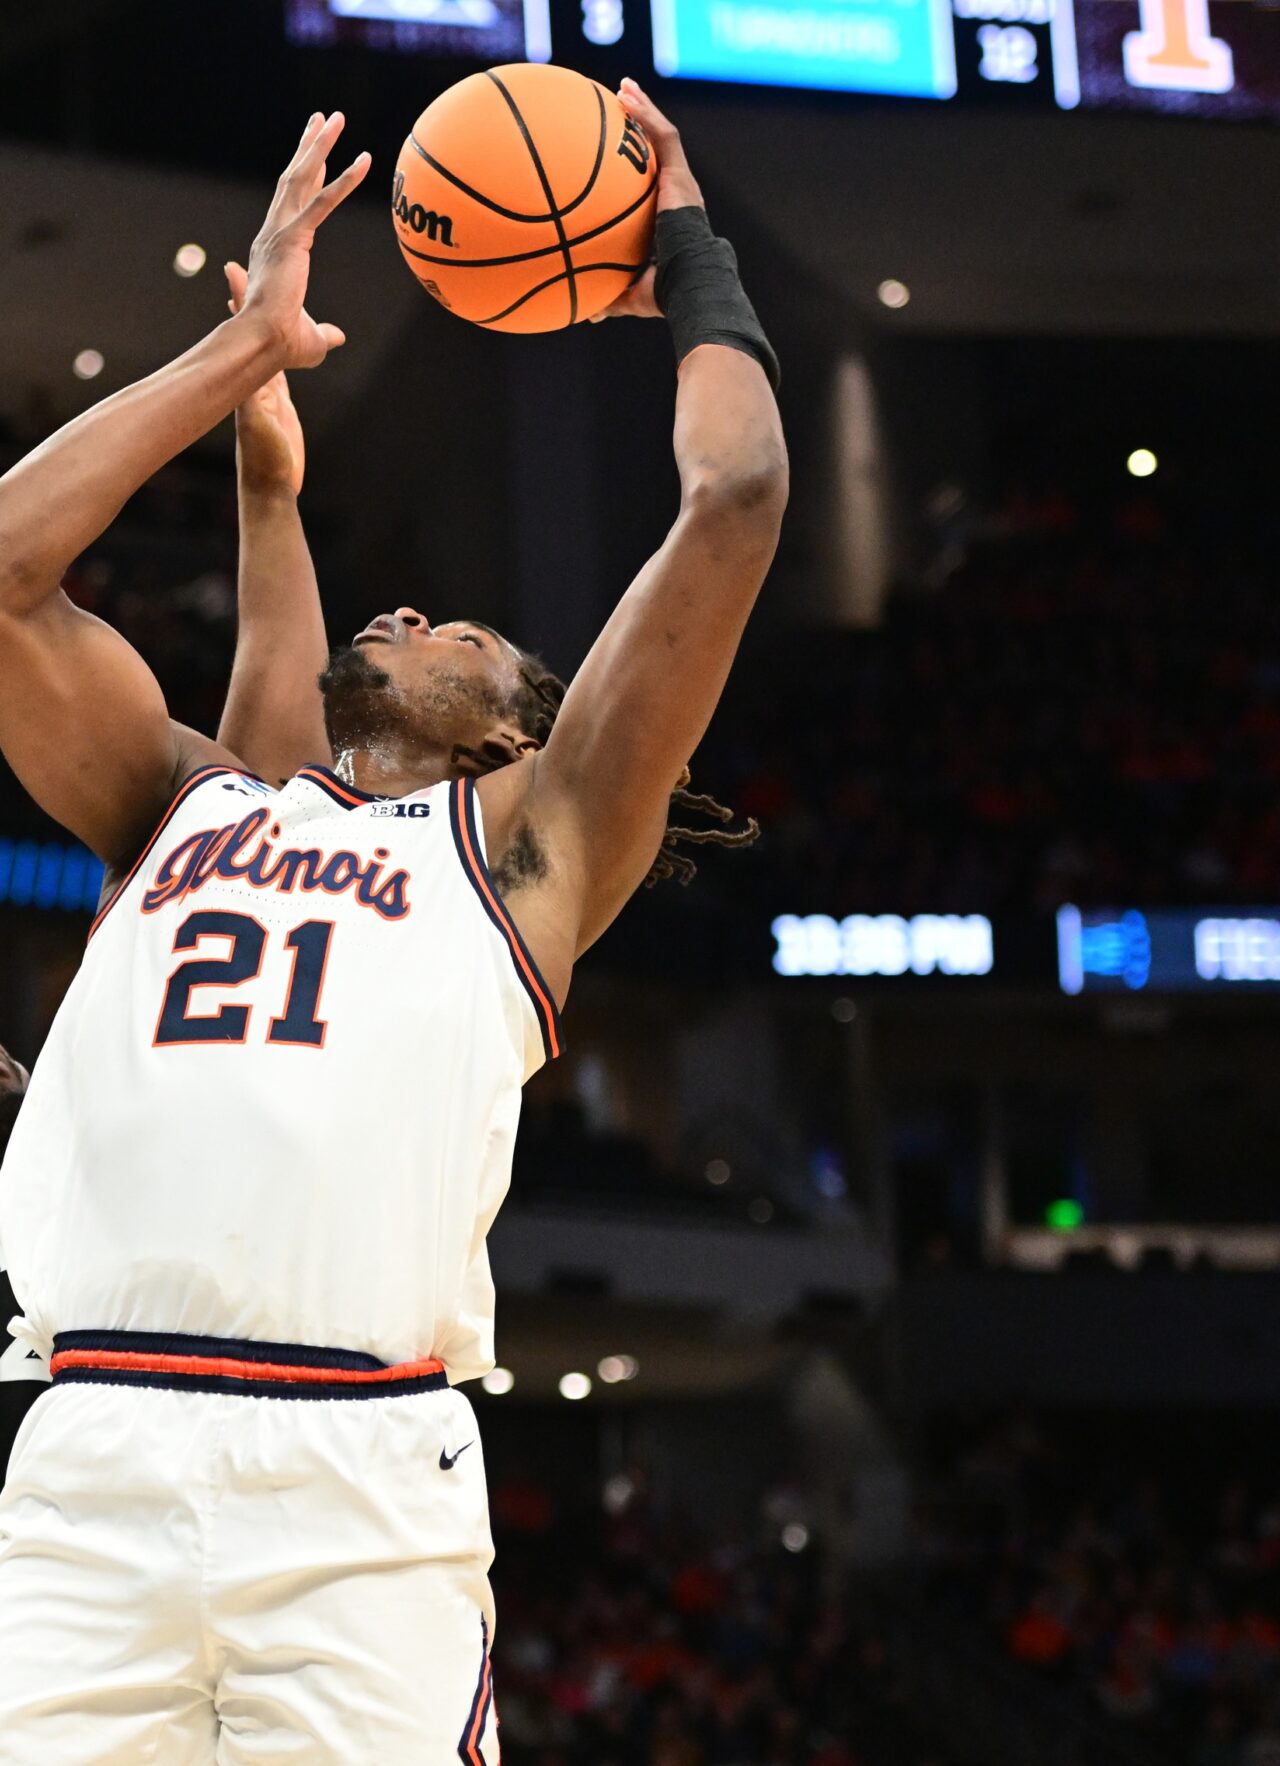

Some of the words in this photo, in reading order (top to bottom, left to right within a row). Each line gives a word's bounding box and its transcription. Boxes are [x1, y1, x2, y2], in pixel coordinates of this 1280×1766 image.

[392, 172, 454, 248] lson
[141, 807, 411, 921] Illinois
[152, 909, 336, 1049] 21
